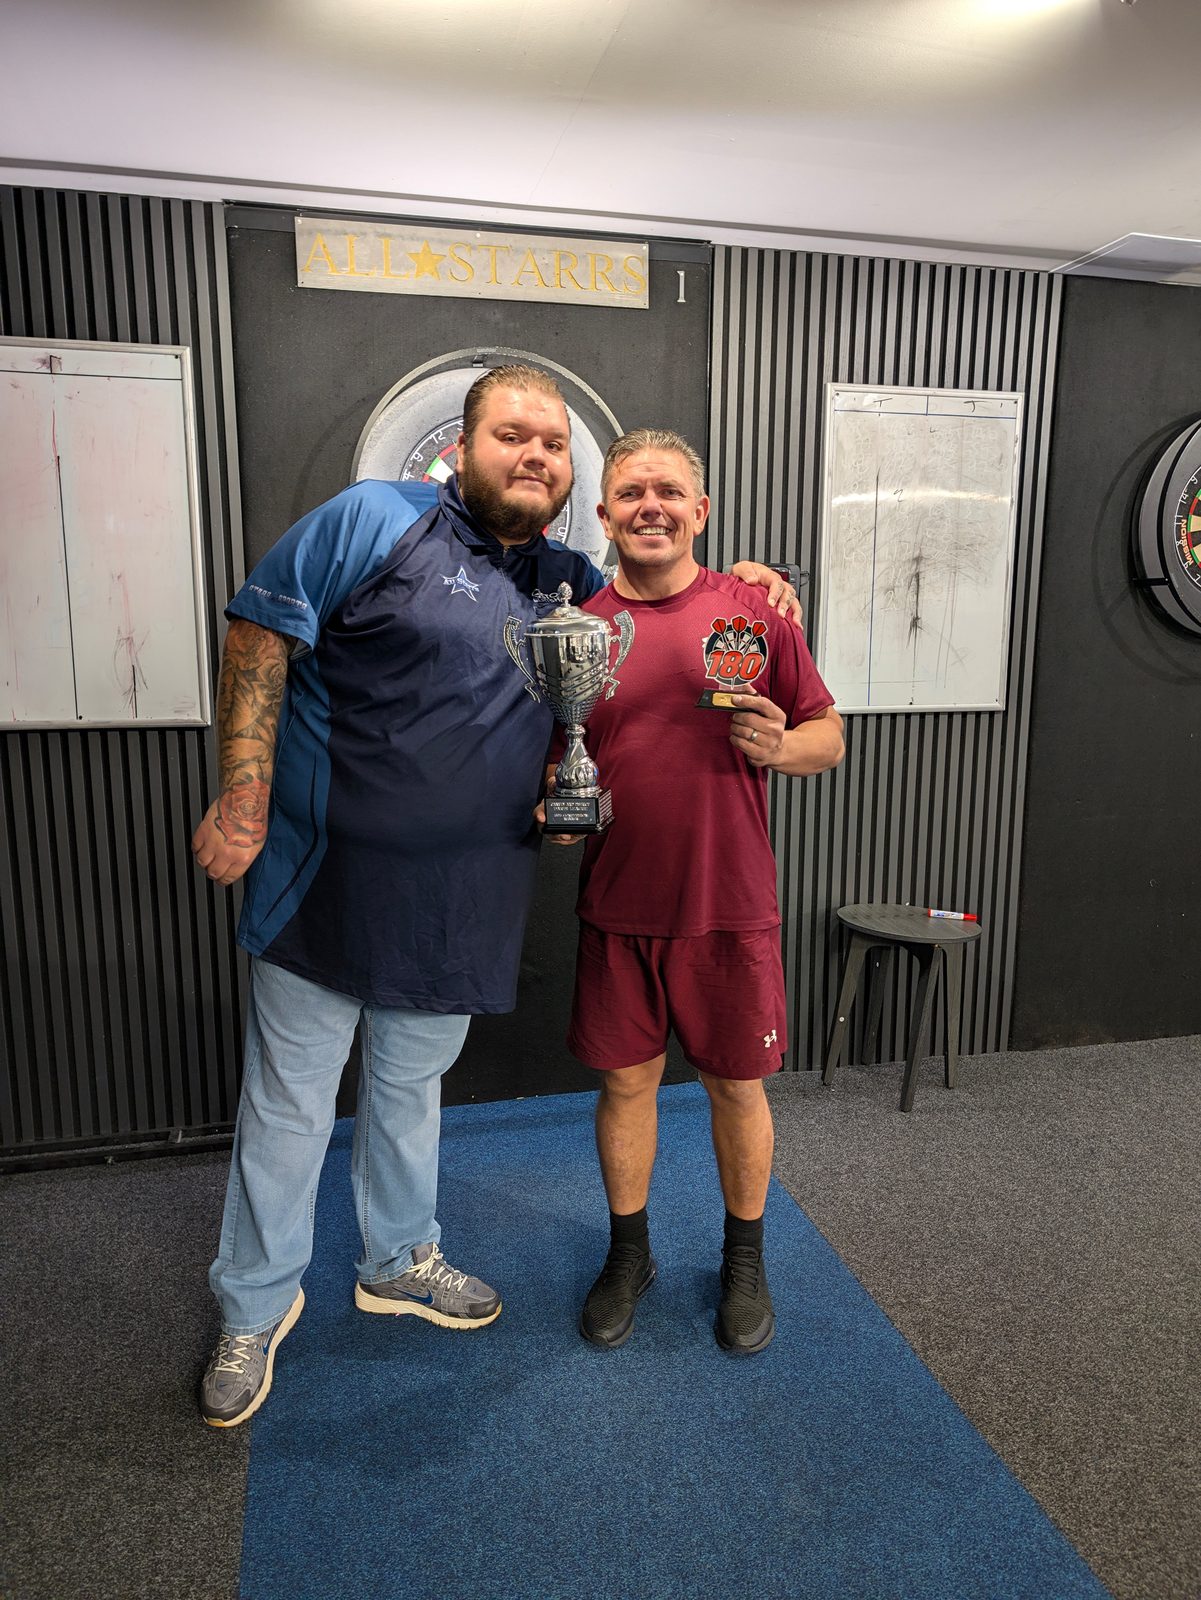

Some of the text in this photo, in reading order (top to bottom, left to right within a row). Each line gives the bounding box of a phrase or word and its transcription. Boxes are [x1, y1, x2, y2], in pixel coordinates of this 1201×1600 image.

[300, 231, 648, 296] ALL STARRS
[1181, 519, 1194, 566] MISSION
[706, 650, 764, 681] 180
